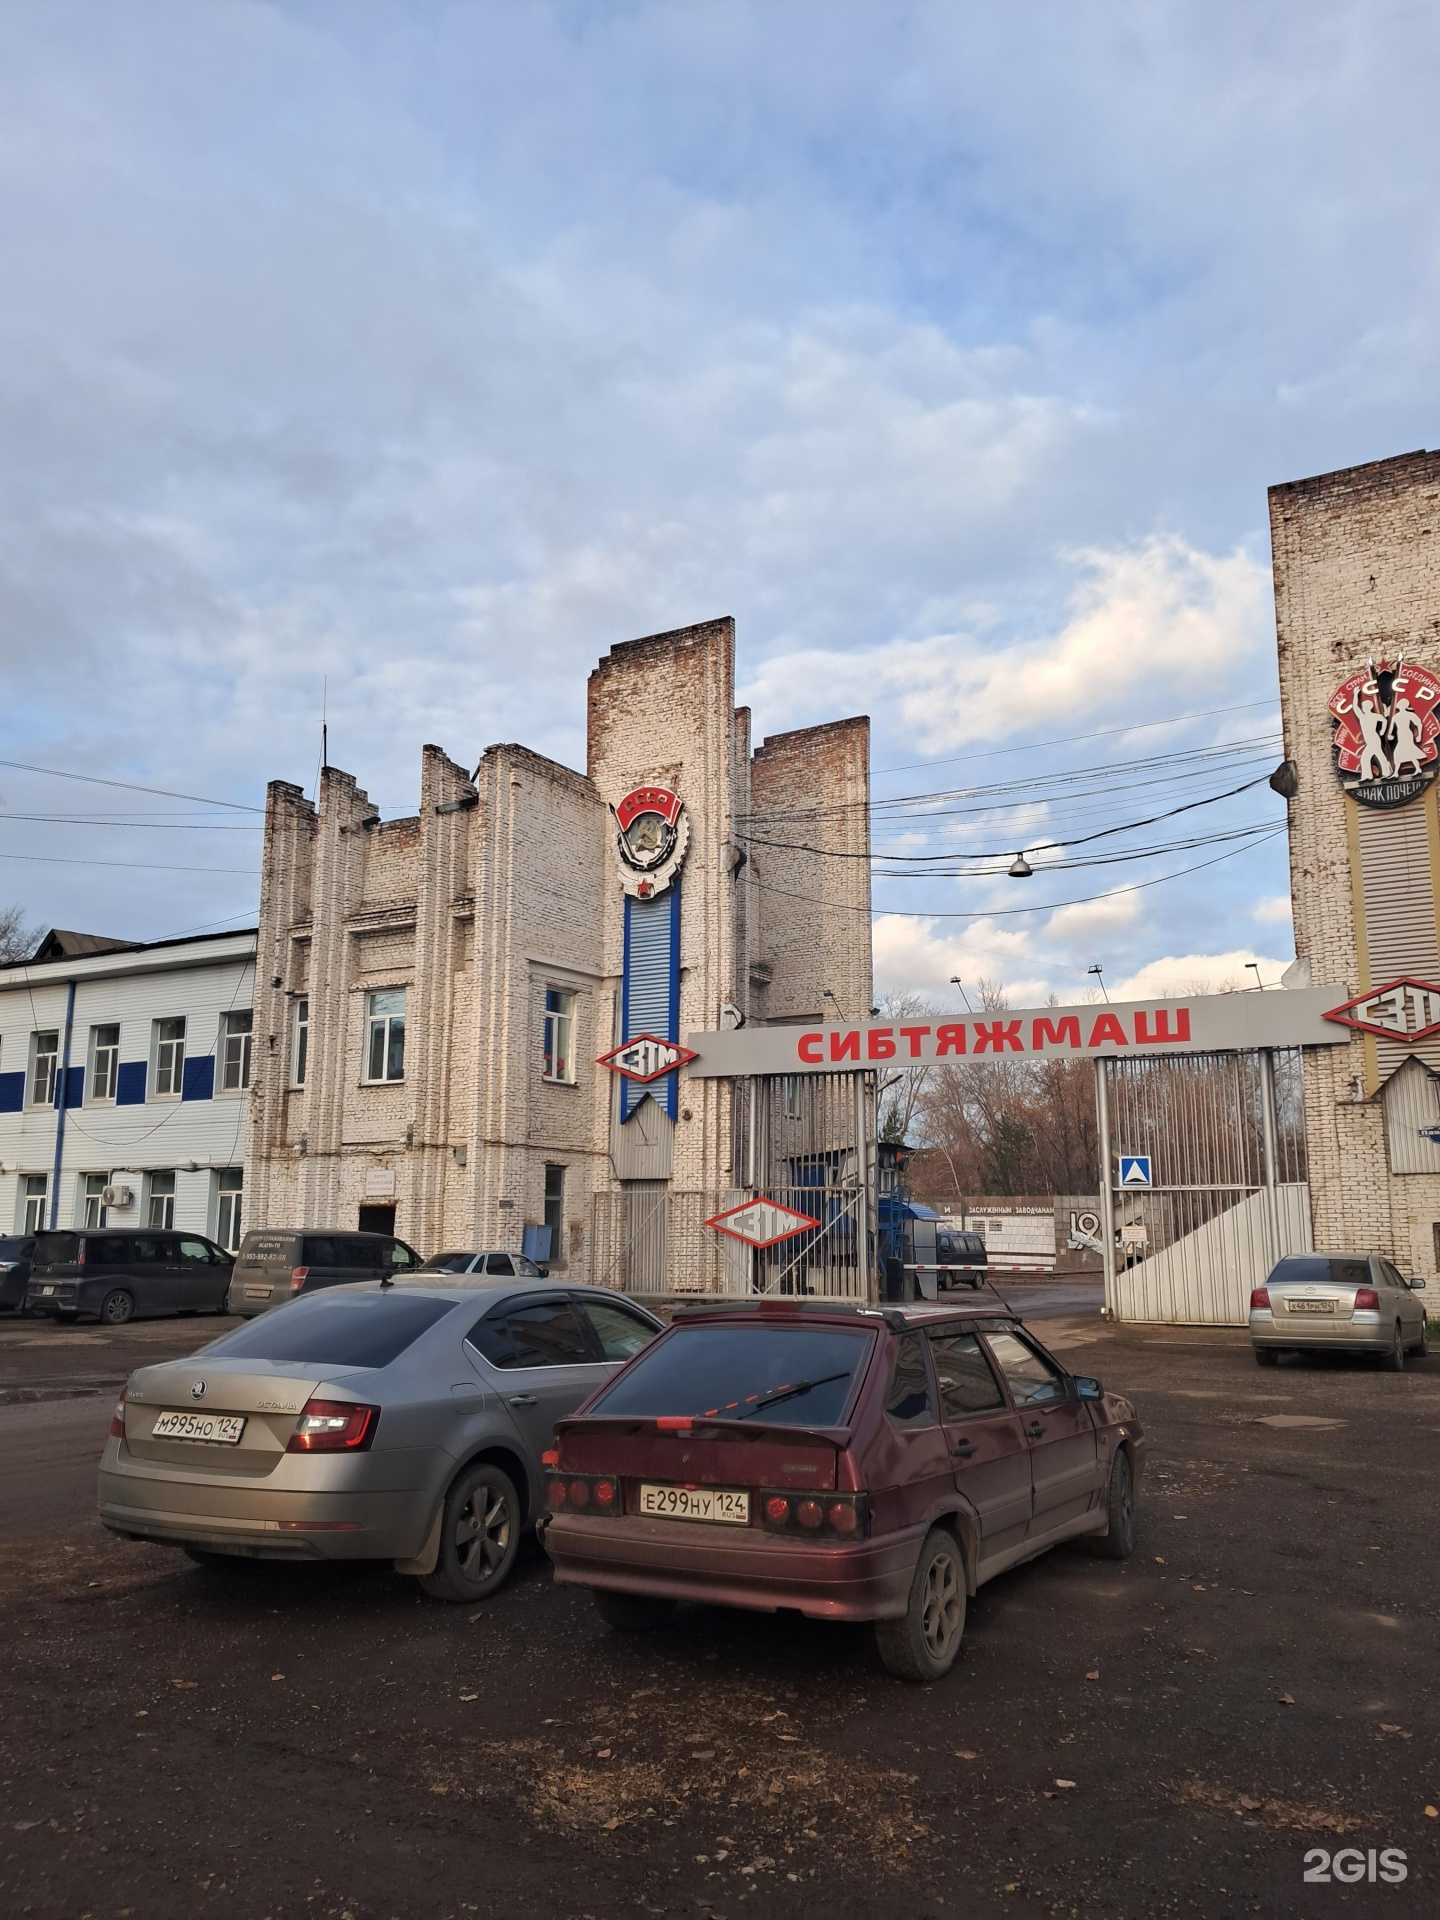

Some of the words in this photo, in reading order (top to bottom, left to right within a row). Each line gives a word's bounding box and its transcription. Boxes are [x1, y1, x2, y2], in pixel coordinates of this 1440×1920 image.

[1336, 678, 1435, 714] СССР
[797, 1007, 1191, 1063] СИБТЯЖМАШ
[615, 1040, 678, 1076] СЗТМ
[969, 1206, 1013, 1214] ЗАСЛУЖЕННЫМ
[157, 1415, 213, 1436] М995НО
[217, 1418, 239, 1434] 124
[646, 1490, 711, 1515] Е299НУ
[716, 1494, 744, 1512] 124
[721, 1511, 736, 1519] RUS
